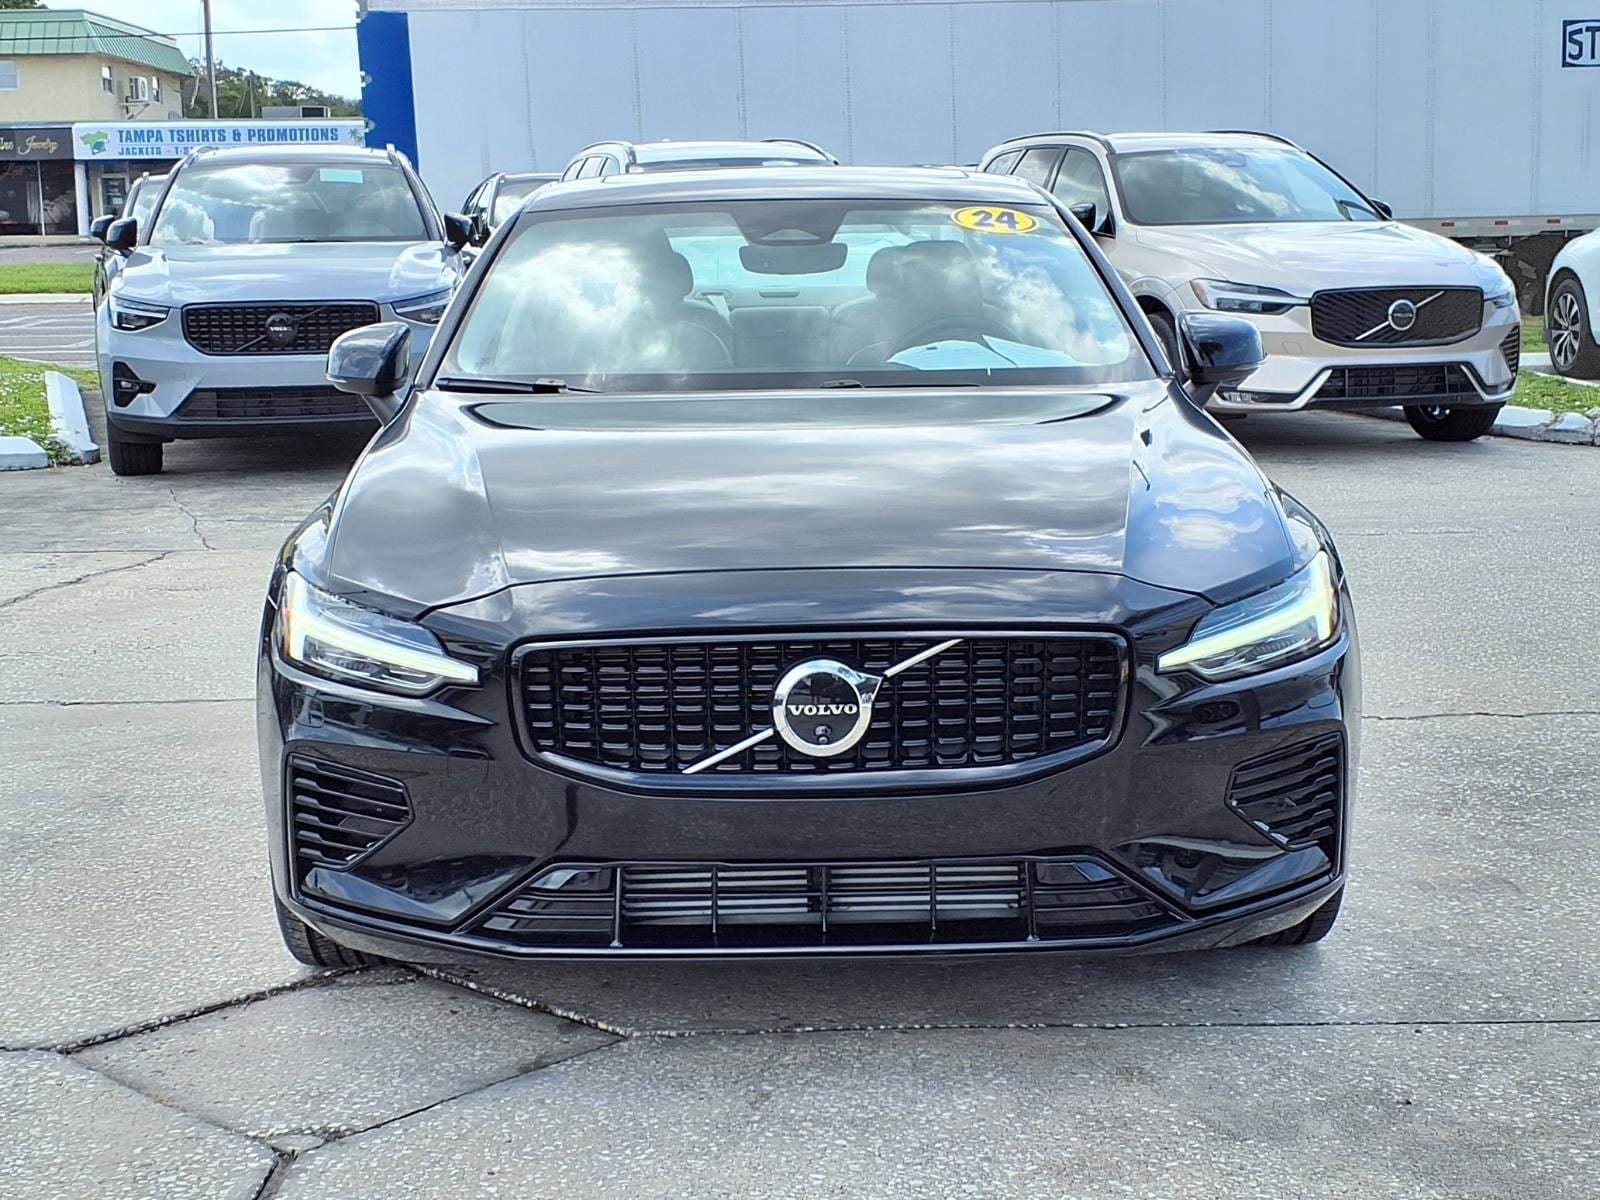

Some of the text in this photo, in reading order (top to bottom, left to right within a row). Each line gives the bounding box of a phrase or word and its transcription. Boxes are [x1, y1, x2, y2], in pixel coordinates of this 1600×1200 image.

[117, 127, 339, 143] TAMPA TSHIRTS & PROMOTIONS
[118, 146, 162, 156] JACKETS
[971, 209, 1019, 230] 24
[787, 703, 858, 716] VOLVO
